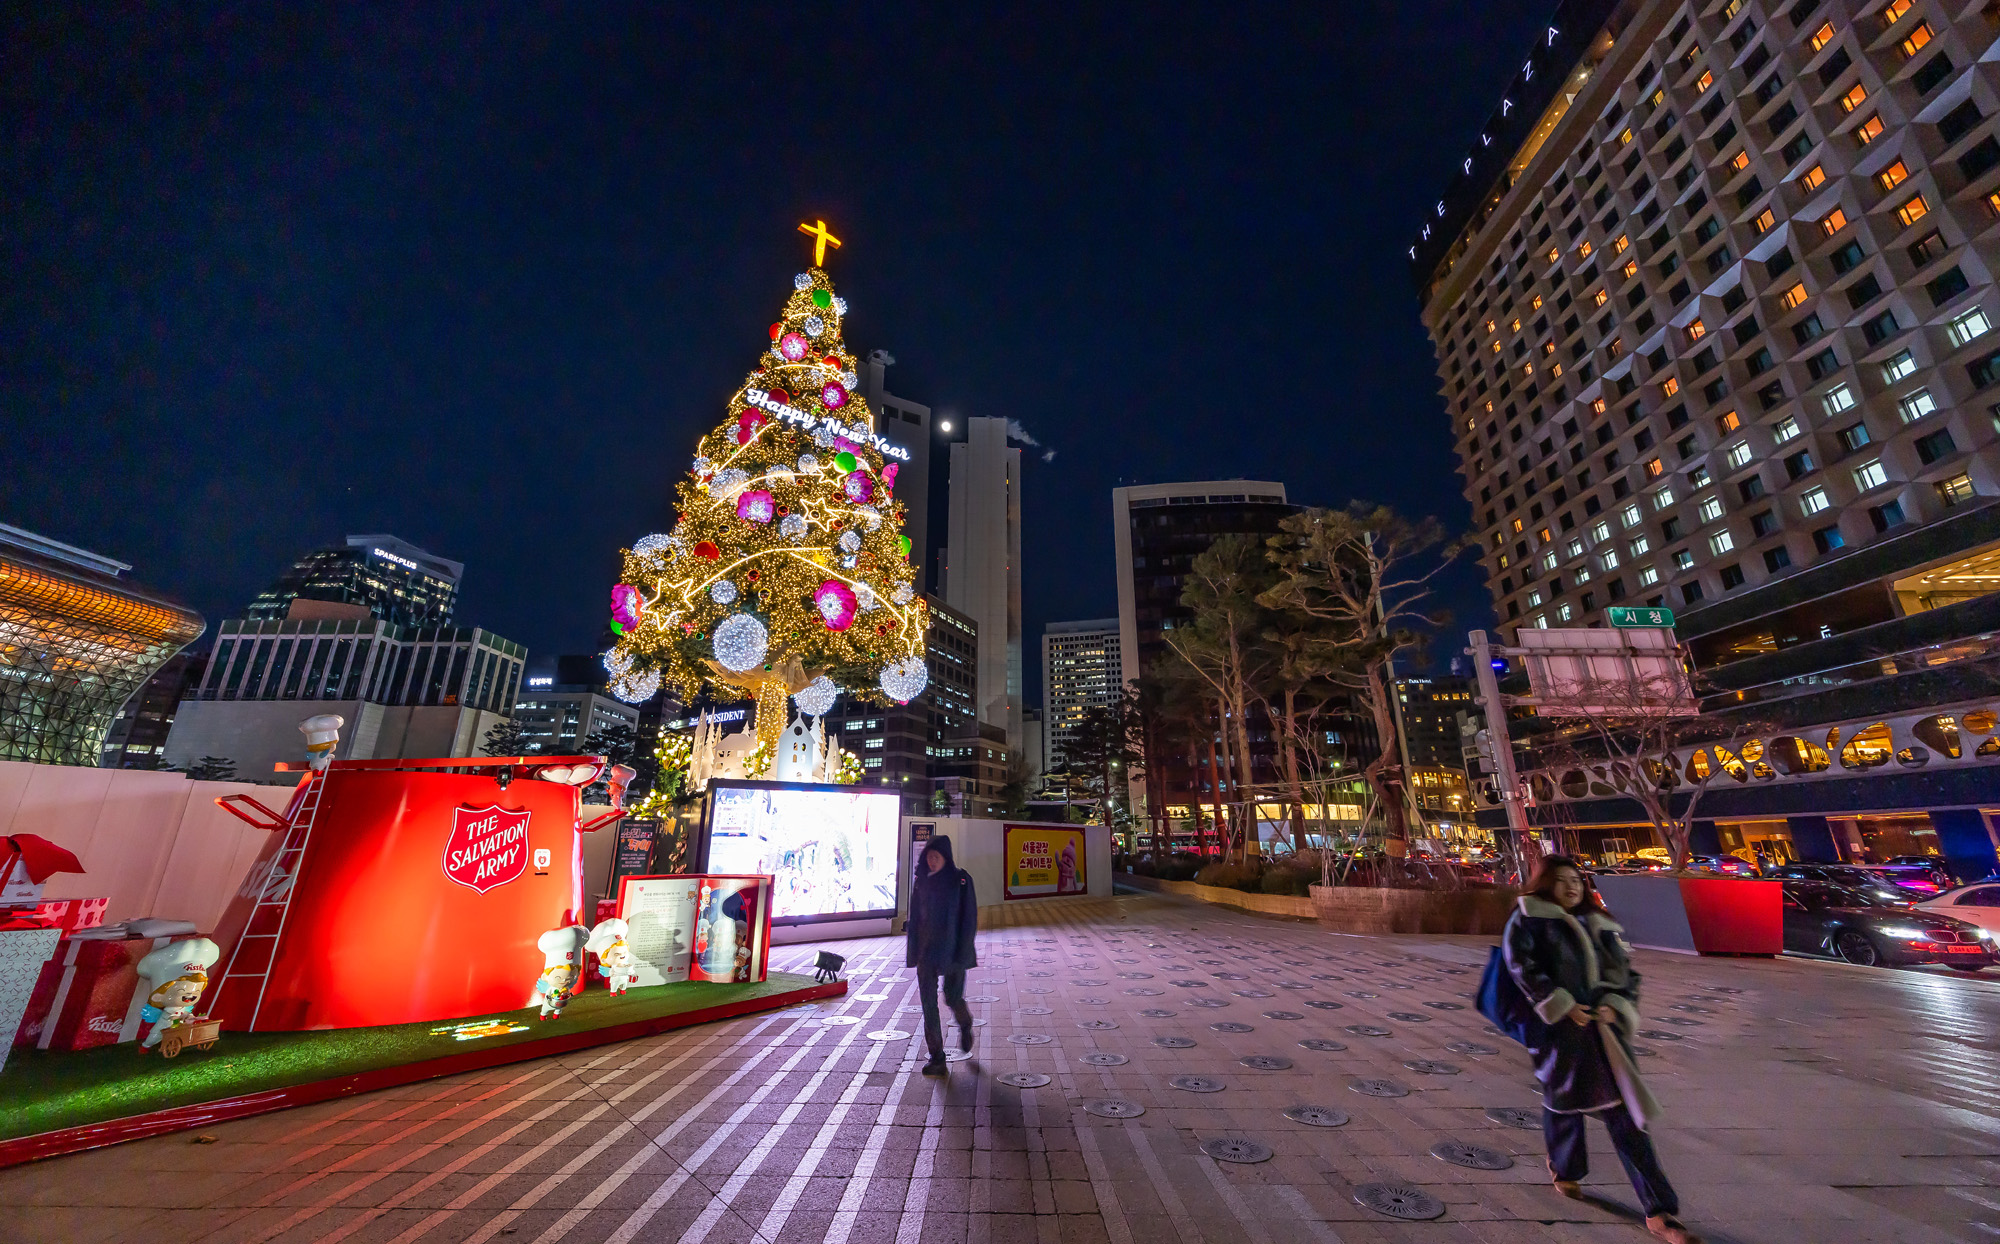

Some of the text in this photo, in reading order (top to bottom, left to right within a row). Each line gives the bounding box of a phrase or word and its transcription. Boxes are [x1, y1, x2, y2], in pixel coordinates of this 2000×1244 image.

[1408, 27, 1559, 260] THE PLAZA
[747, 388, 910, 461] Happy New Year
[449, 819, 526, 871] SALVATION
[466, 815, 499, 840] THE
[1022, 840, 1049, 855] 서울광장
[473, 844, 520, 884] ARMY
[1019, 856, 1053, 871] 스케이트장
